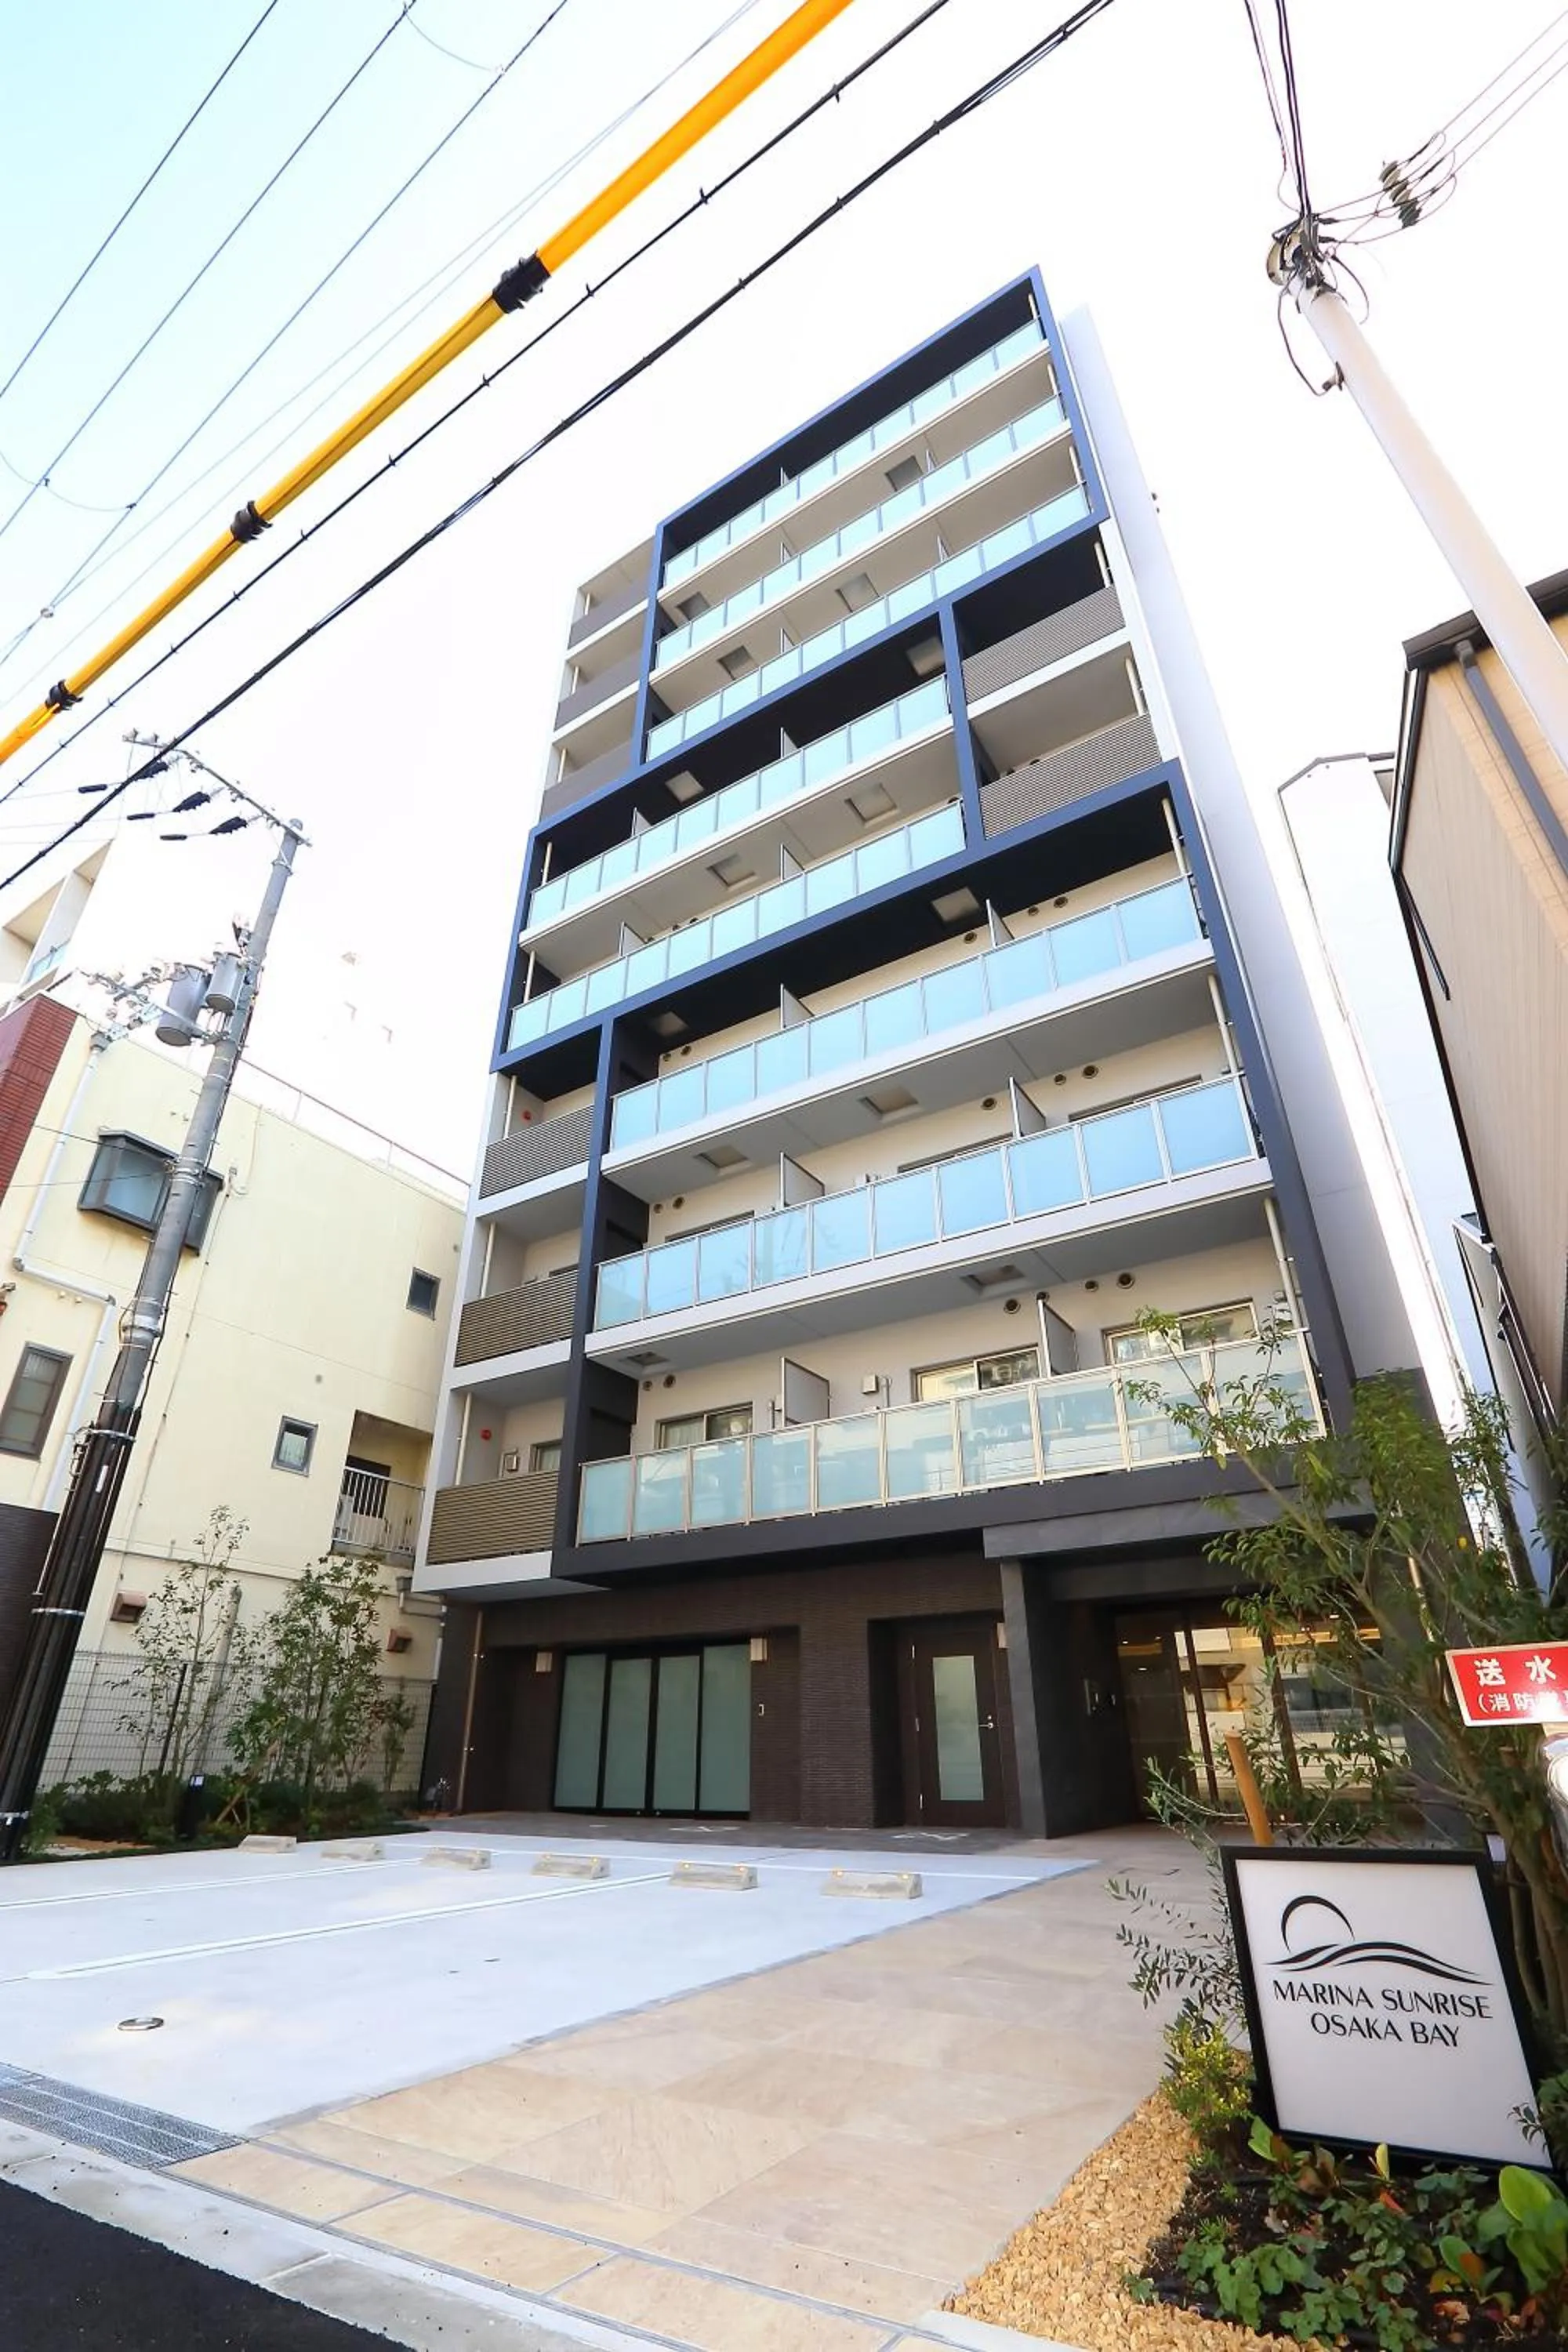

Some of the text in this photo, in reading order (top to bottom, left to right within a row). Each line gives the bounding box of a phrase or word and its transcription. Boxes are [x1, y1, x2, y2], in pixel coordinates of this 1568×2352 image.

[1272, 1980, 1494, 2020] MARINA SUNRISE
[1310, 2012, 1461, 2048] OSAKA BAY
